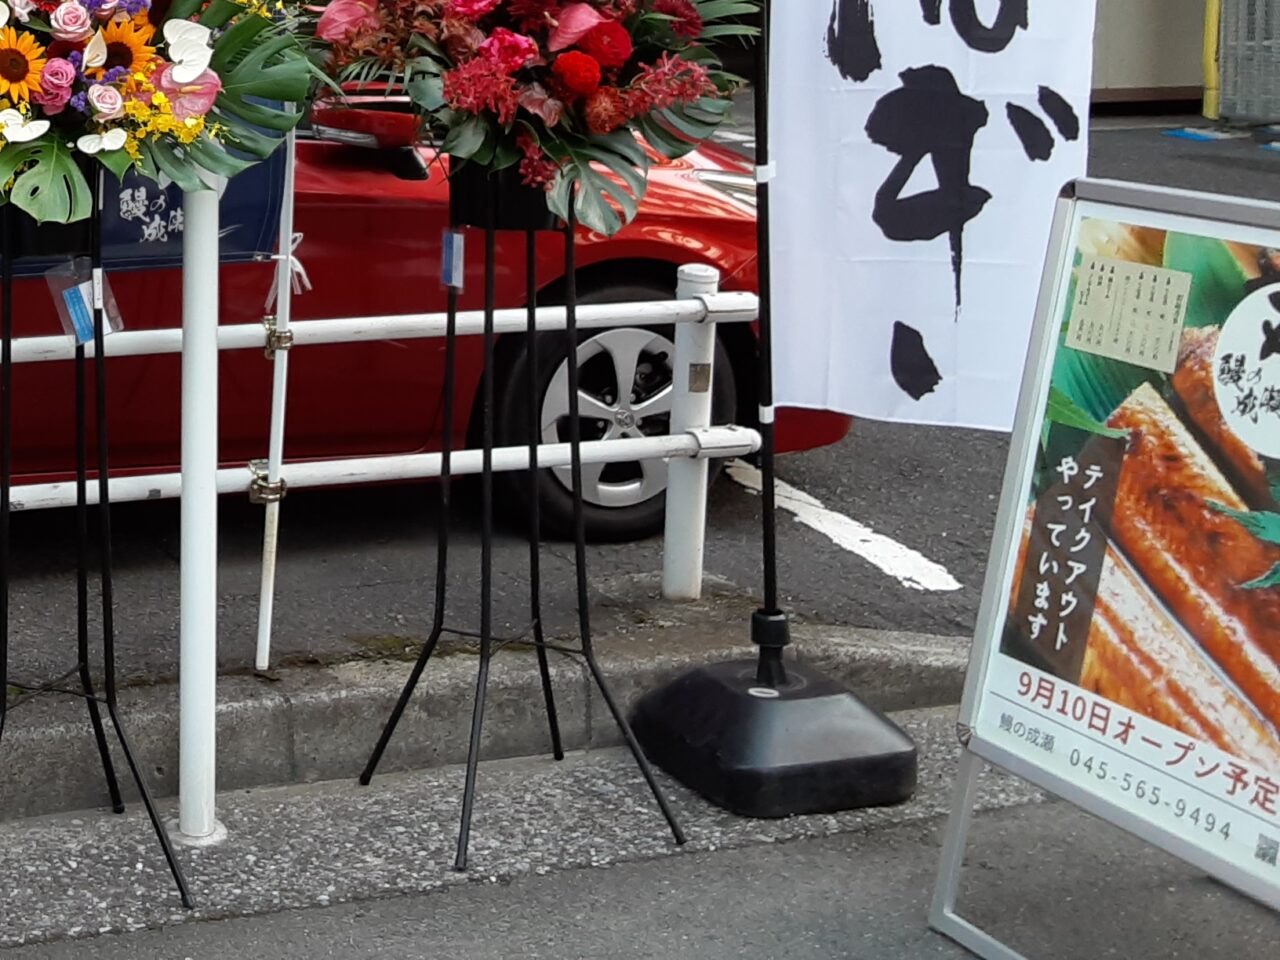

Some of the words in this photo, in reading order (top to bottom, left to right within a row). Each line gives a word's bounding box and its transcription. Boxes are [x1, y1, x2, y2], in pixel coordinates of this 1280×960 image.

[1027, 456, 1080, 640] やっています
[1055, 463, 1104, 651] テイクアウト
[1017, 671, 1280, 816] 9月10日オープン予定
[1069, 749, 1233, 841] 045-565-9494
